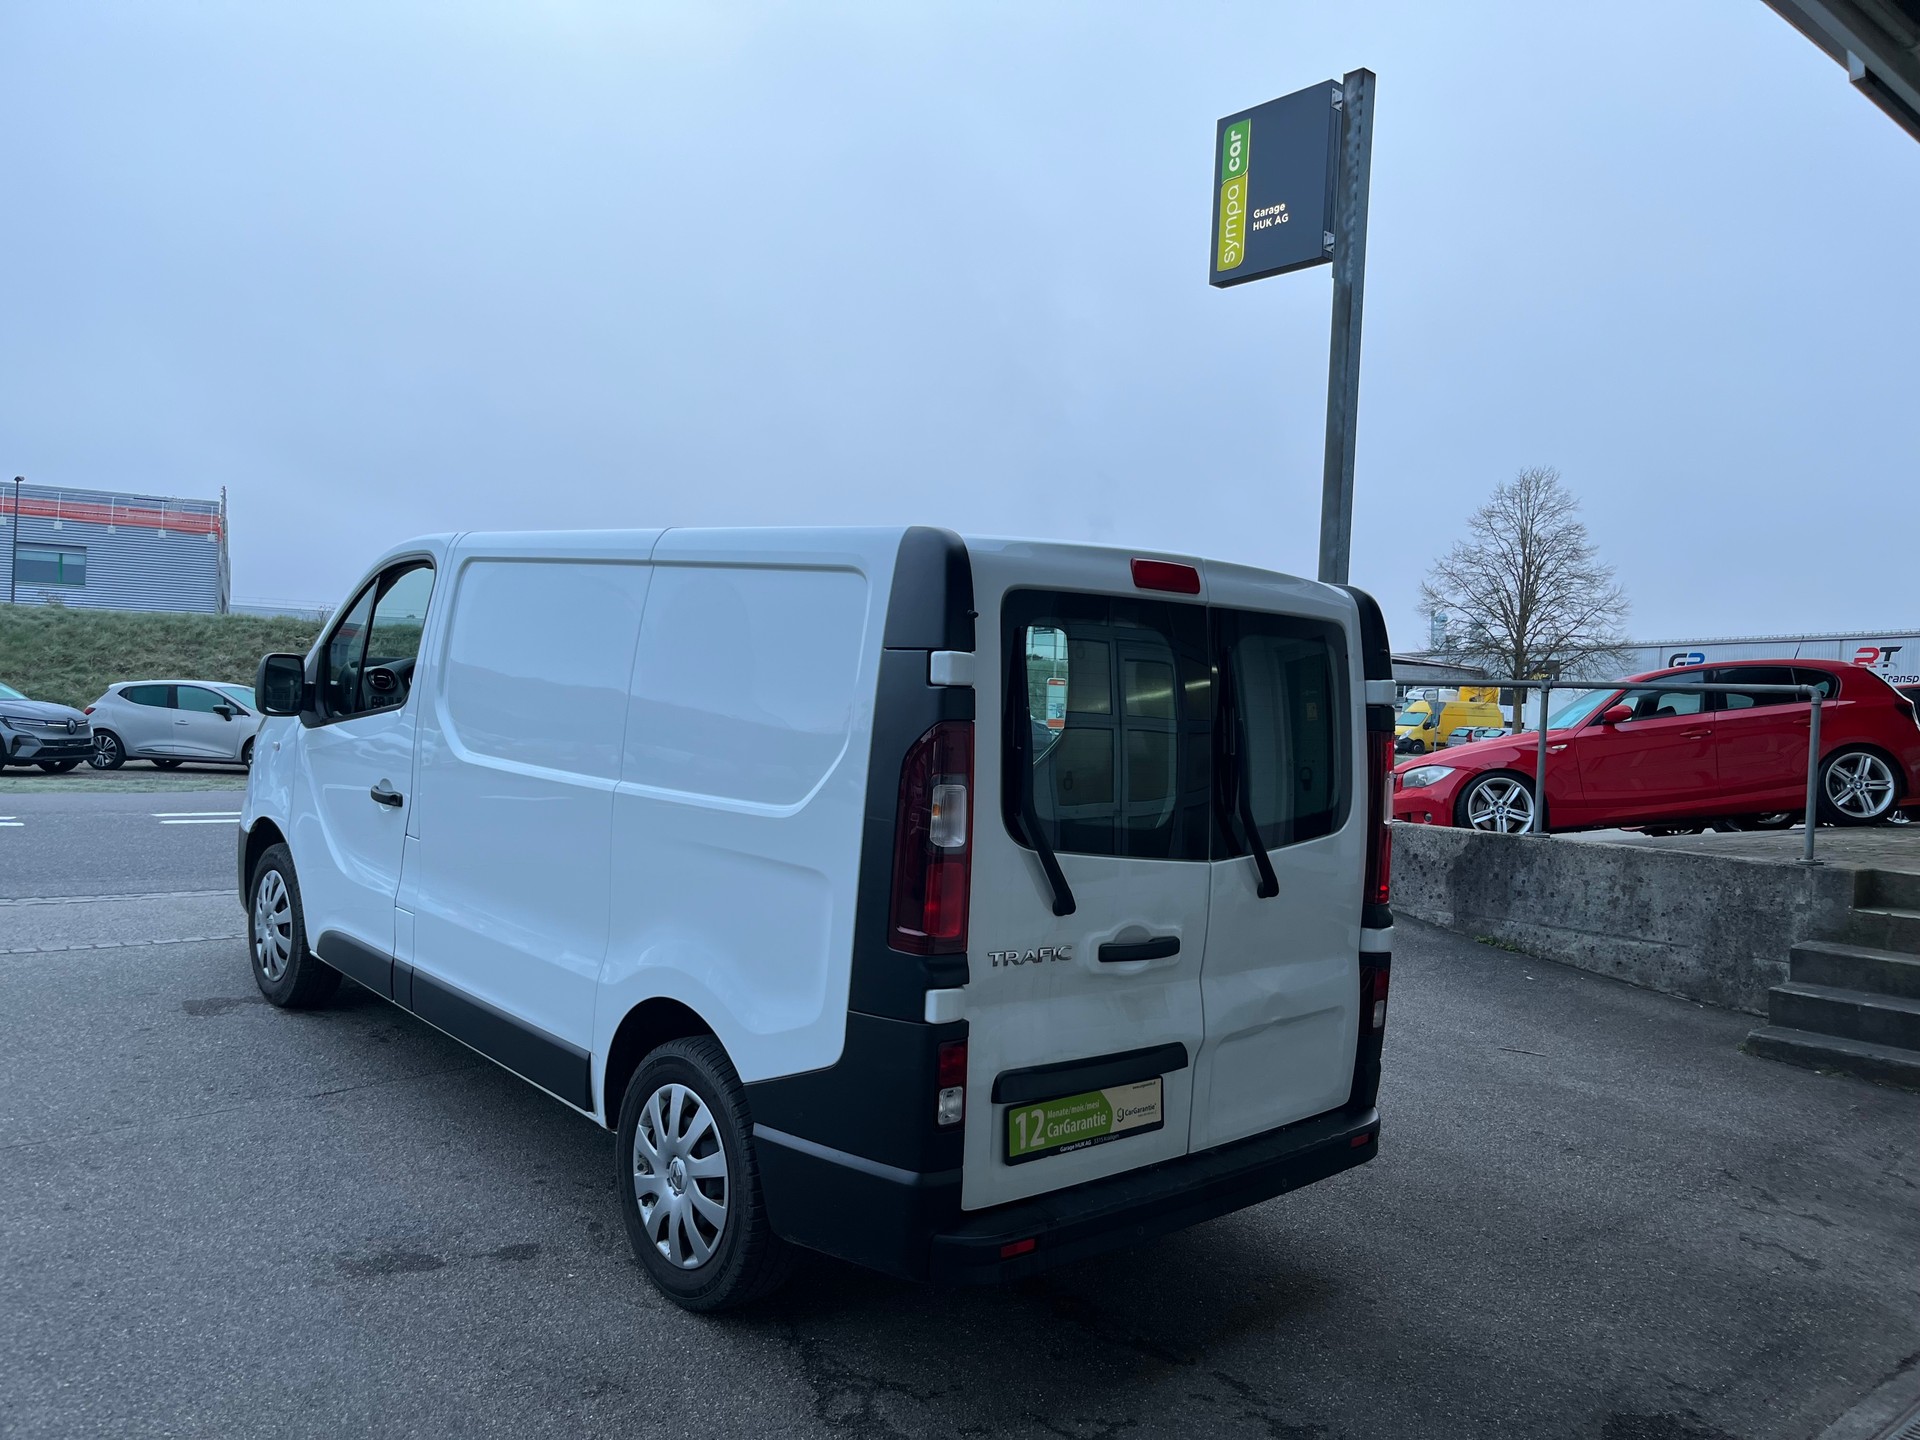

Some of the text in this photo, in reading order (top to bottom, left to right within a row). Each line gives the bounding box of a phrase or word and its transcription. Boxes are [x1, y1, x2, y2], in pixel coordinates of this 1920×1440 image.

[1224, 130, 1242, 264] sympa car
[1253, 202, 1286, 219] Garage
[1253, 212, 1289, 231] HUK AG
[1882, 673, 1920, 684] Transp
[987, 945, 1073, 967] TRAFIC
[1015, 1108, 1045, 1151] 12
[1060, 1145, 1075, 1153] Garage
